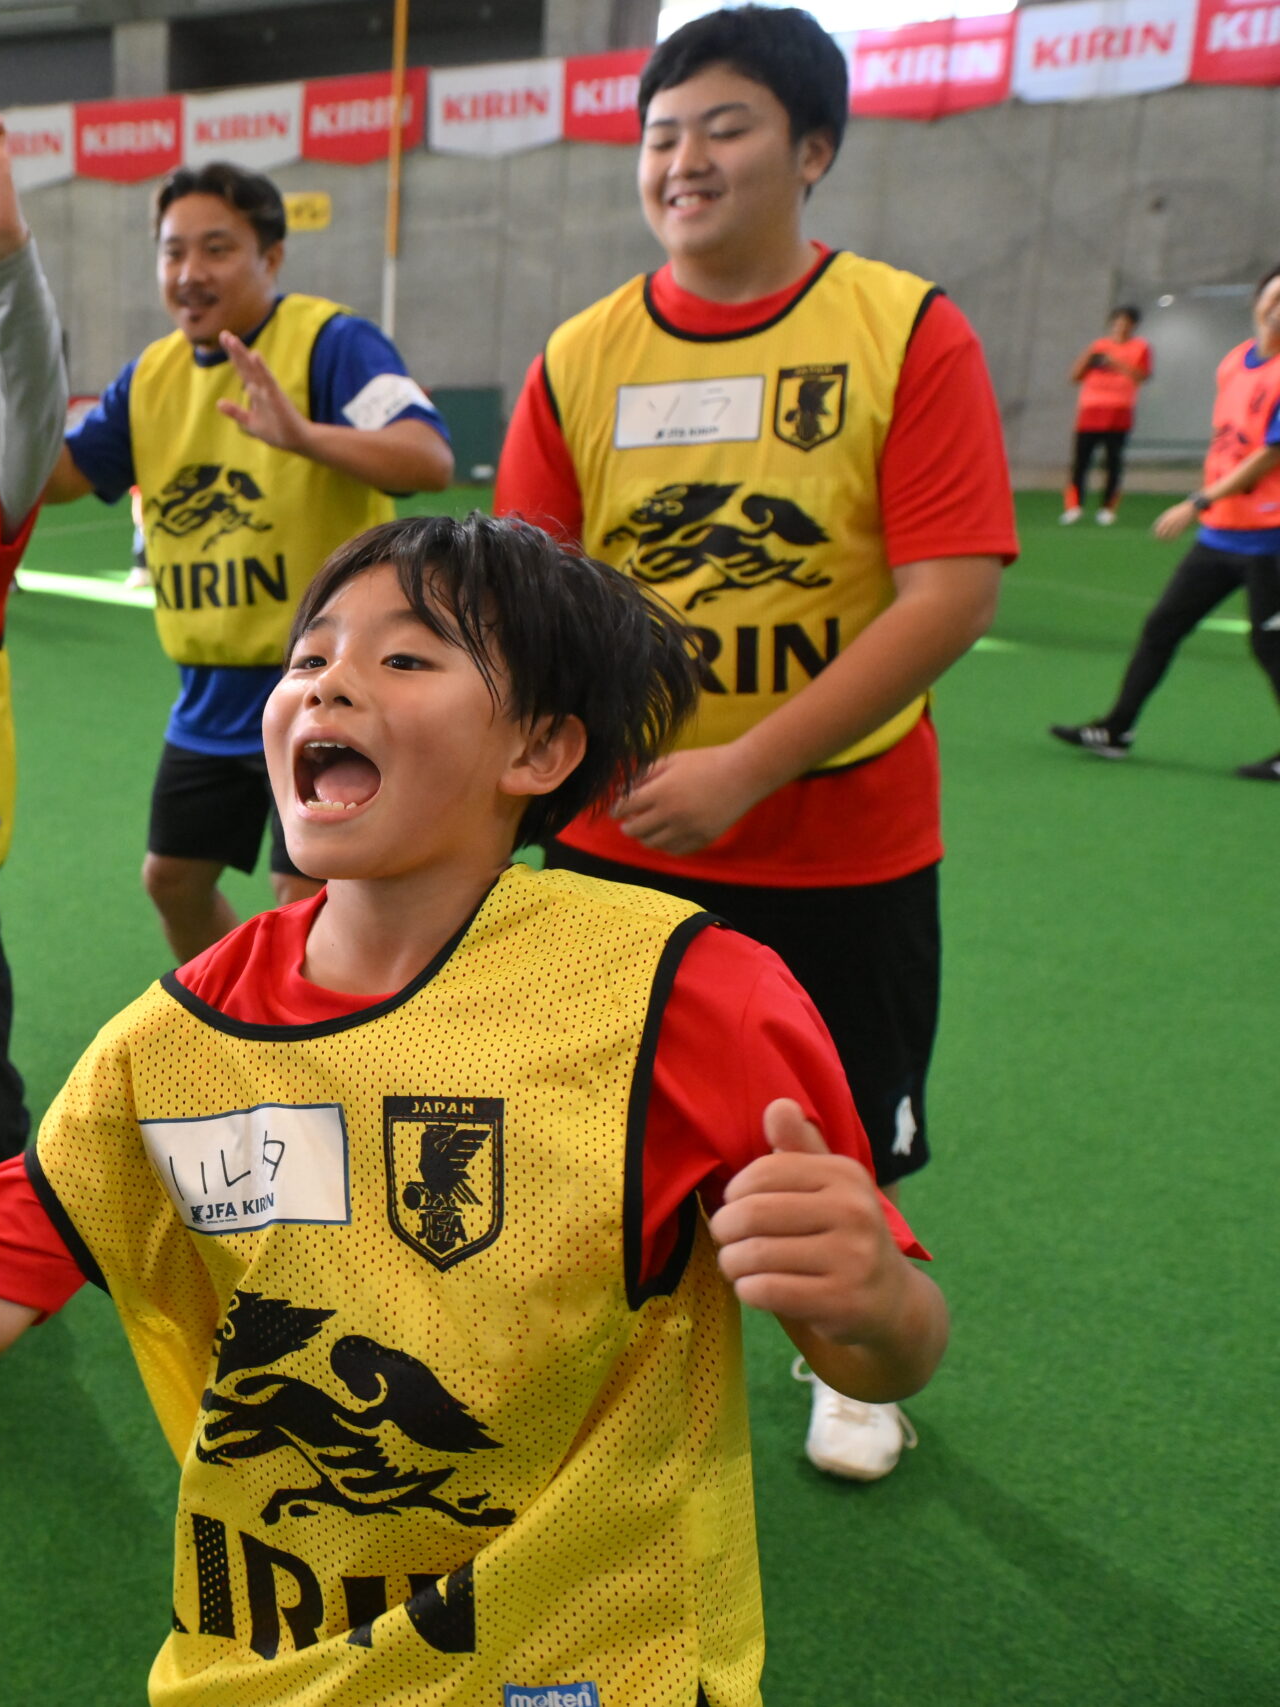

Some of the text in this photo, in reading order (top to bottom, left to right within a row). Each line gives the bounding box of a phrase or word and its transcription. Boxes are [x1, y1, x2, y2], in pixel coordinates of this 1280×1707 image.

[864, 38, 1003, 89] KIRIN
[1031, 22, 1176, 71] KIRIN
[442, 87, 550, 123] KIRIN
[572, 74, 639, 117] KIR
[194, 110, 291, 144] KIRIN
[308, 94, 413, 138] KIRIN
[81, 120, 175, 156] KIRIN
[682, 617, 839, 695] RIN
[411, 1101, 475, 1115] JAPAN
[205, 1202, 238, 1220] JFA
[510, 1690, 592, 1707] molten
